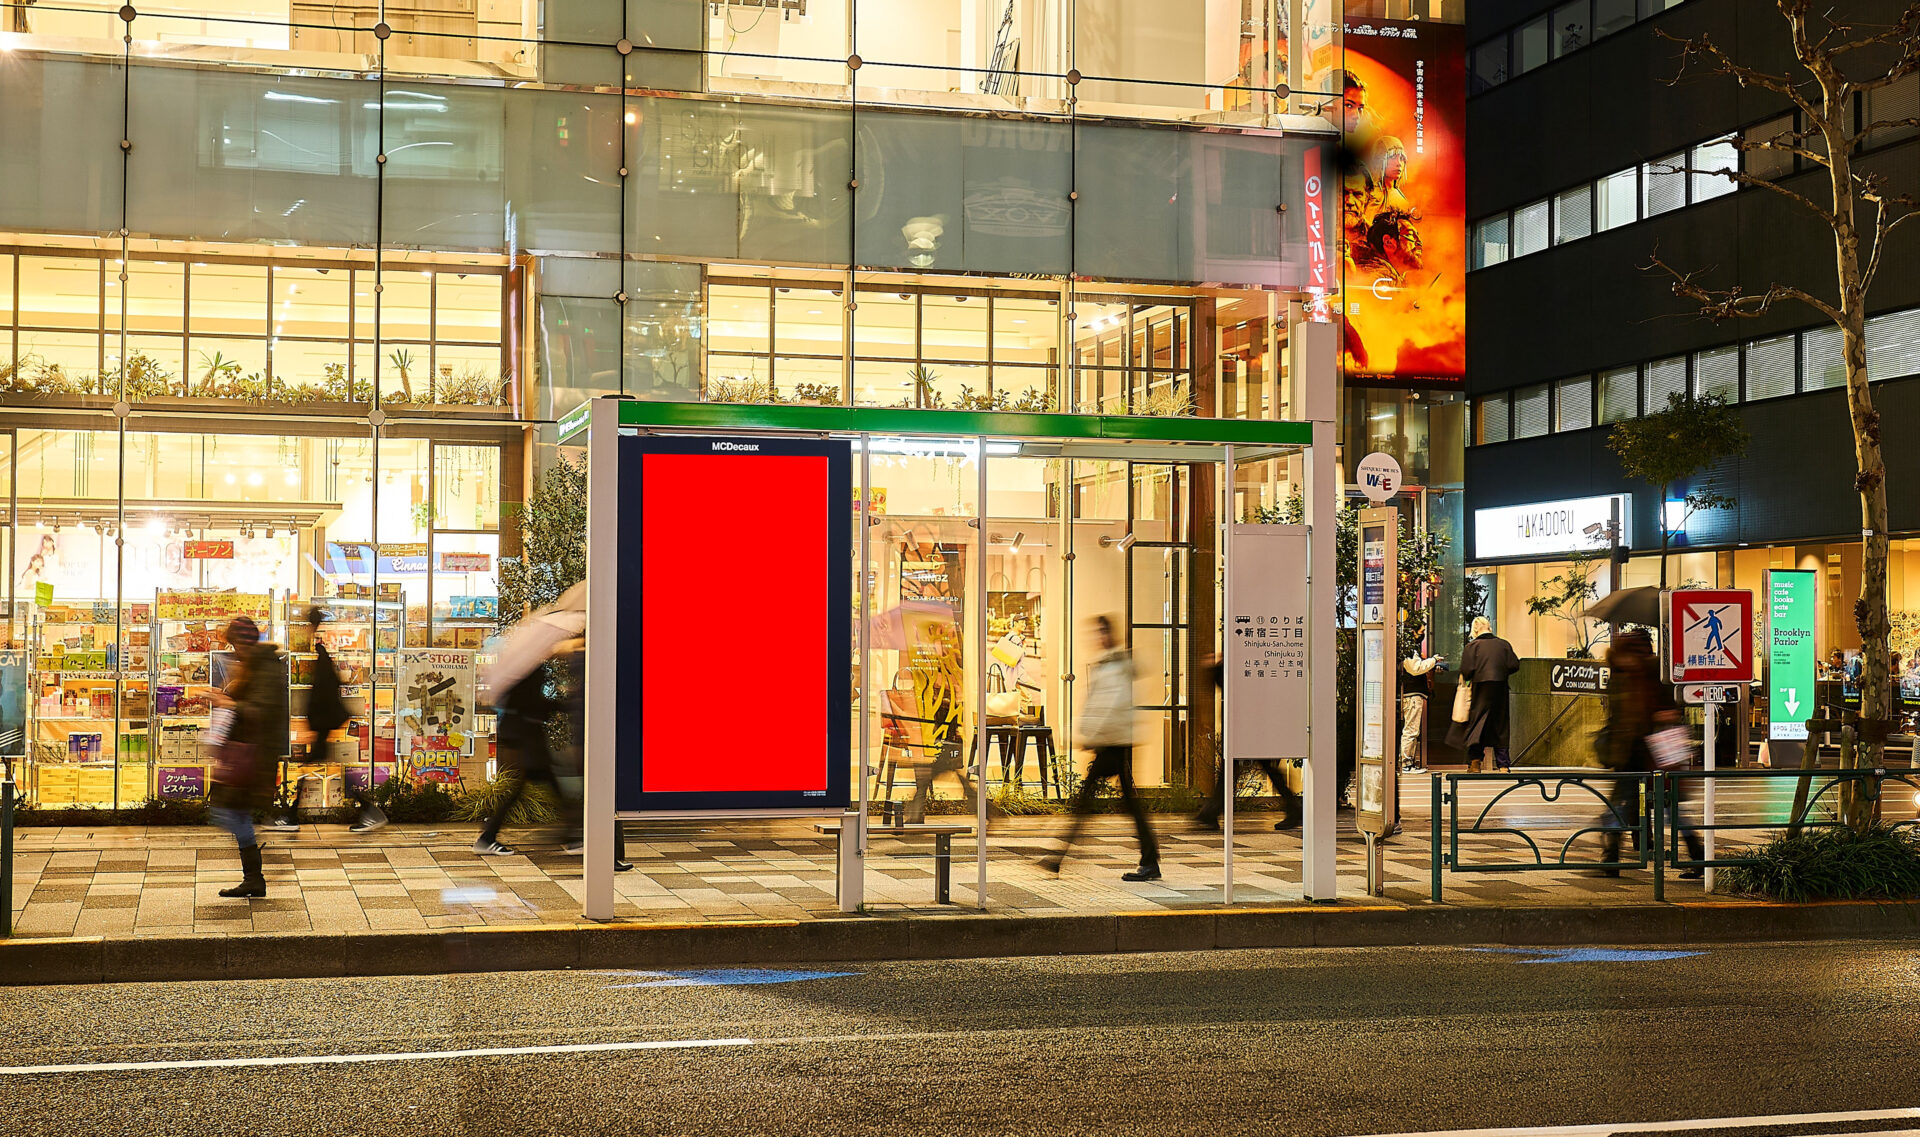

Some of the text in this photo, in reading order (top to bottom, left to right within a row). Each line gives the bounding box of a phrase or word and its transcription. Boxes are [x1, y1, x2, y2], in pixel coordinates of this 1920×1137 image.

[712, 442, 759, 451] MCDecaux
[1518, 510, 1574, 538] HAKADORU
[186, 544, 232, 558] オープン
[1244, 628, 1303, 638] 新宿三丁目
[1774, 628, 1811, 638] Brooklyn
[1774, 637, 1799, 646] Parlor
[1265, 650, 1303, 658] (Shinjuku 3)
[1688, 654, 1726, 666] 横断禁止
[1564, 665, 1599, 679] コインロッカー
[1703, 687, 1723, 701] NERO
[413, 751, 459, 768] OPEN
[166, 775, 197, 783] クッキー
[162, 784, 199, 793] ビスケット
